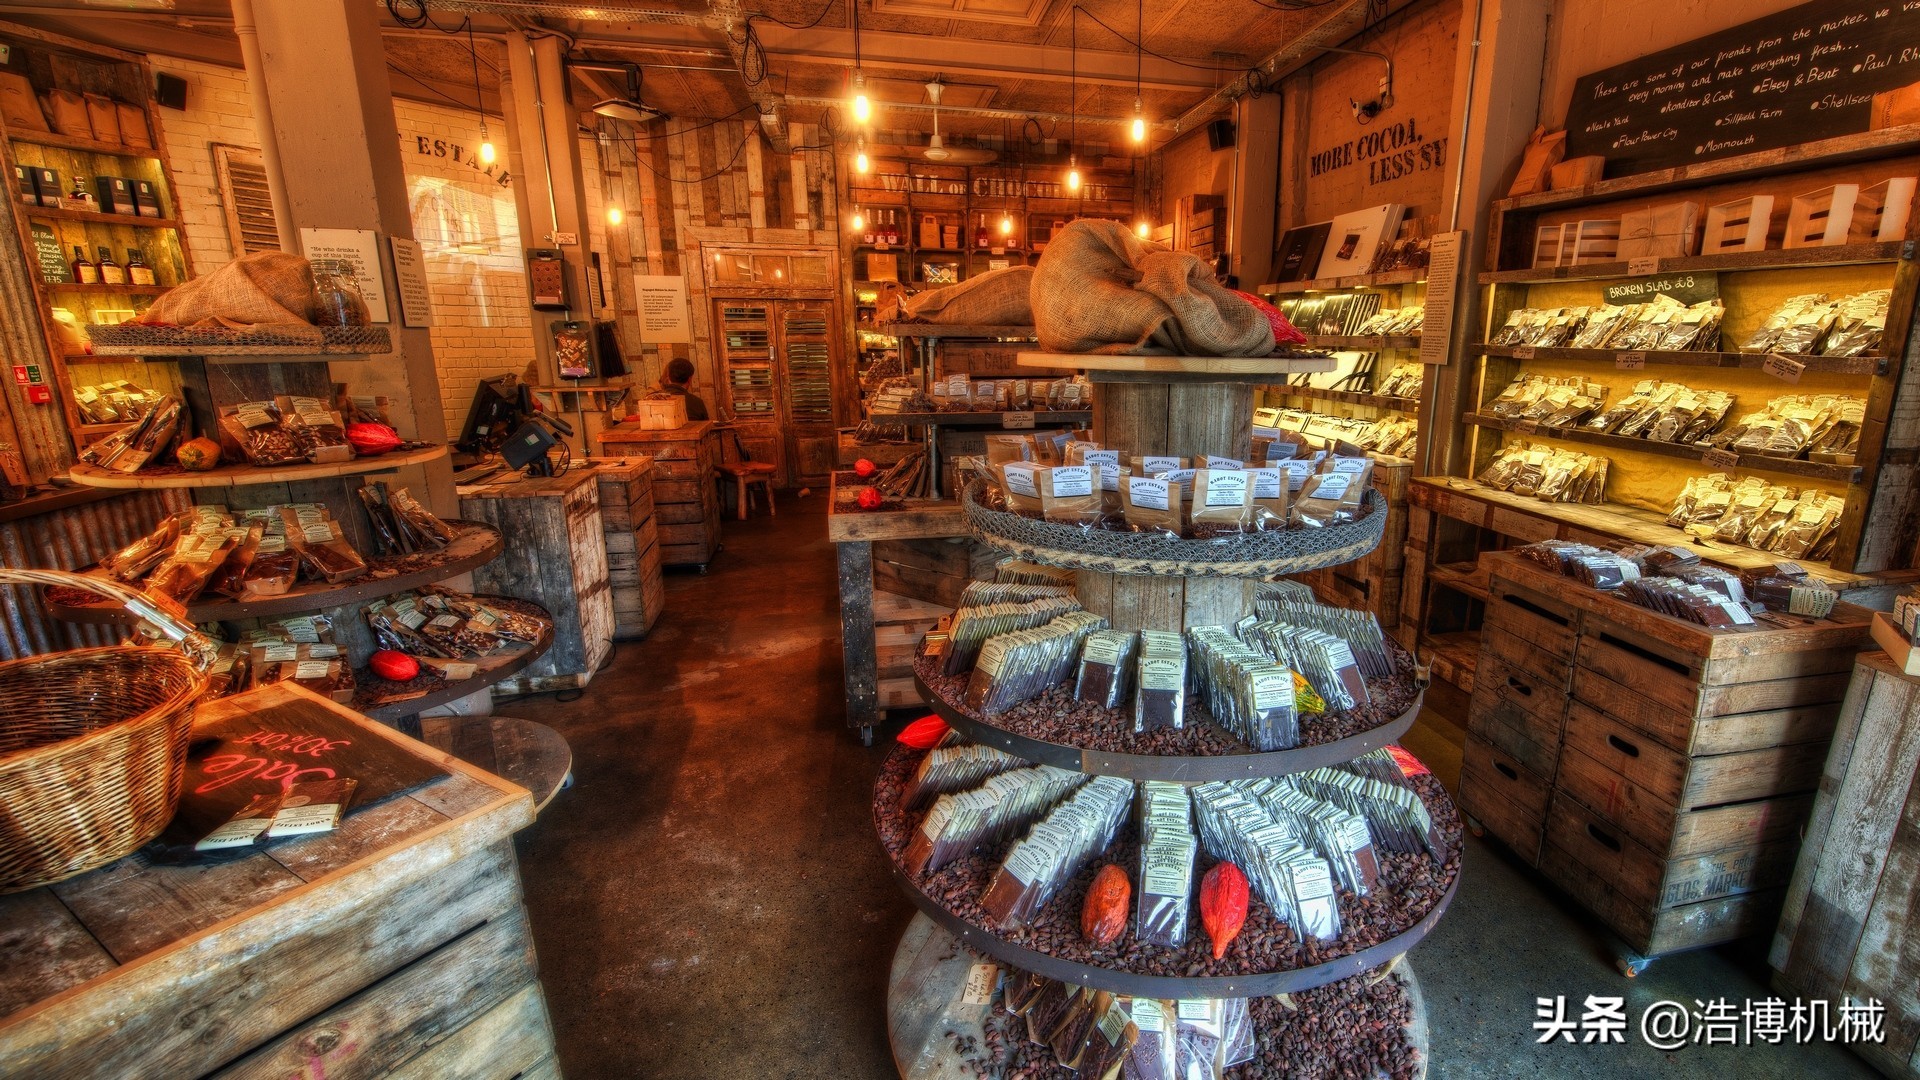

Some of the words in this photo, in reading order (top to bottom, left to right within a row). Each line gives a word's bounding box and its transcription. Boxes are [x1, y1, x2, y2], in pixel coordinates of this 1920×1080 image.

[1594, 81, 1618, 100] These
[1622, 80, 1639, 91] are
[1646, 72, 1666, 84] some
[1672, 64, 1684, 77] of
[1691, 57, 1710, 69] our
[1715, 45, 1752, 68] friends
[1757, 37, 1782, 54] from
[1792, 29, 1811, 41] the
[1862, 54, 1892, 71] Paul
[1629, 90, 1649, 103] every
[1653, 82, 1685, 93] morning
[1691, 73, 1711, 88] and
[1718, 67, 1743, 80] make
[1751, 53, 1801, 72] everything
[1760, 77, 1790, 93] Elsey
[1794, 73, 1804, 86] &
[1806, 67, 1840, 84] Bent
[1702, 93, 1711, 106] &
[1712, 89, 1735, 102] Cook
[1759, 109, 1783, 119] Farm
[1640, 130, 1662, 142] Power
[1310, 142, 1353, 178] MORE
[1357, 117, 1423, 161] COCOA,
[1703, 135, 1755, 154] Monmouth
[416, 135, 513, 189] ESTATE
[1369, 150, 1414, 186] LESS
[1420, 137, 1448, 171] SU
[879, 172, 944, 193] WALL
[1646, 280, 1672, 293] SLAB
[1675, 276, 1695, 289] £8
[1161, 460, 1178, 469] ESTATE
[1055, 468, 1070, 477] RABOT
[1071, 467, 1089, 475] ESTATE
[1259, 471, 1278, 480] ESTATE
[1148, 482, 1166, 492] ESTATE
[1210, 476, 1227, 485] RABOT
[1228, 476, 1245, 484] ESTATE
[1144, 659, 1160, 668] RABOT
[1160, 659, 1179, 669] ESTATE
[1255, 676, 1270, 687] RABOT
[1270, 675, 1289, 683] ESTATE
[1148, 863, 1164, 871] RABOT
[1165, 863, 1183, 873] ESTATE
[1294, 866, 1309, 877] RABOT
